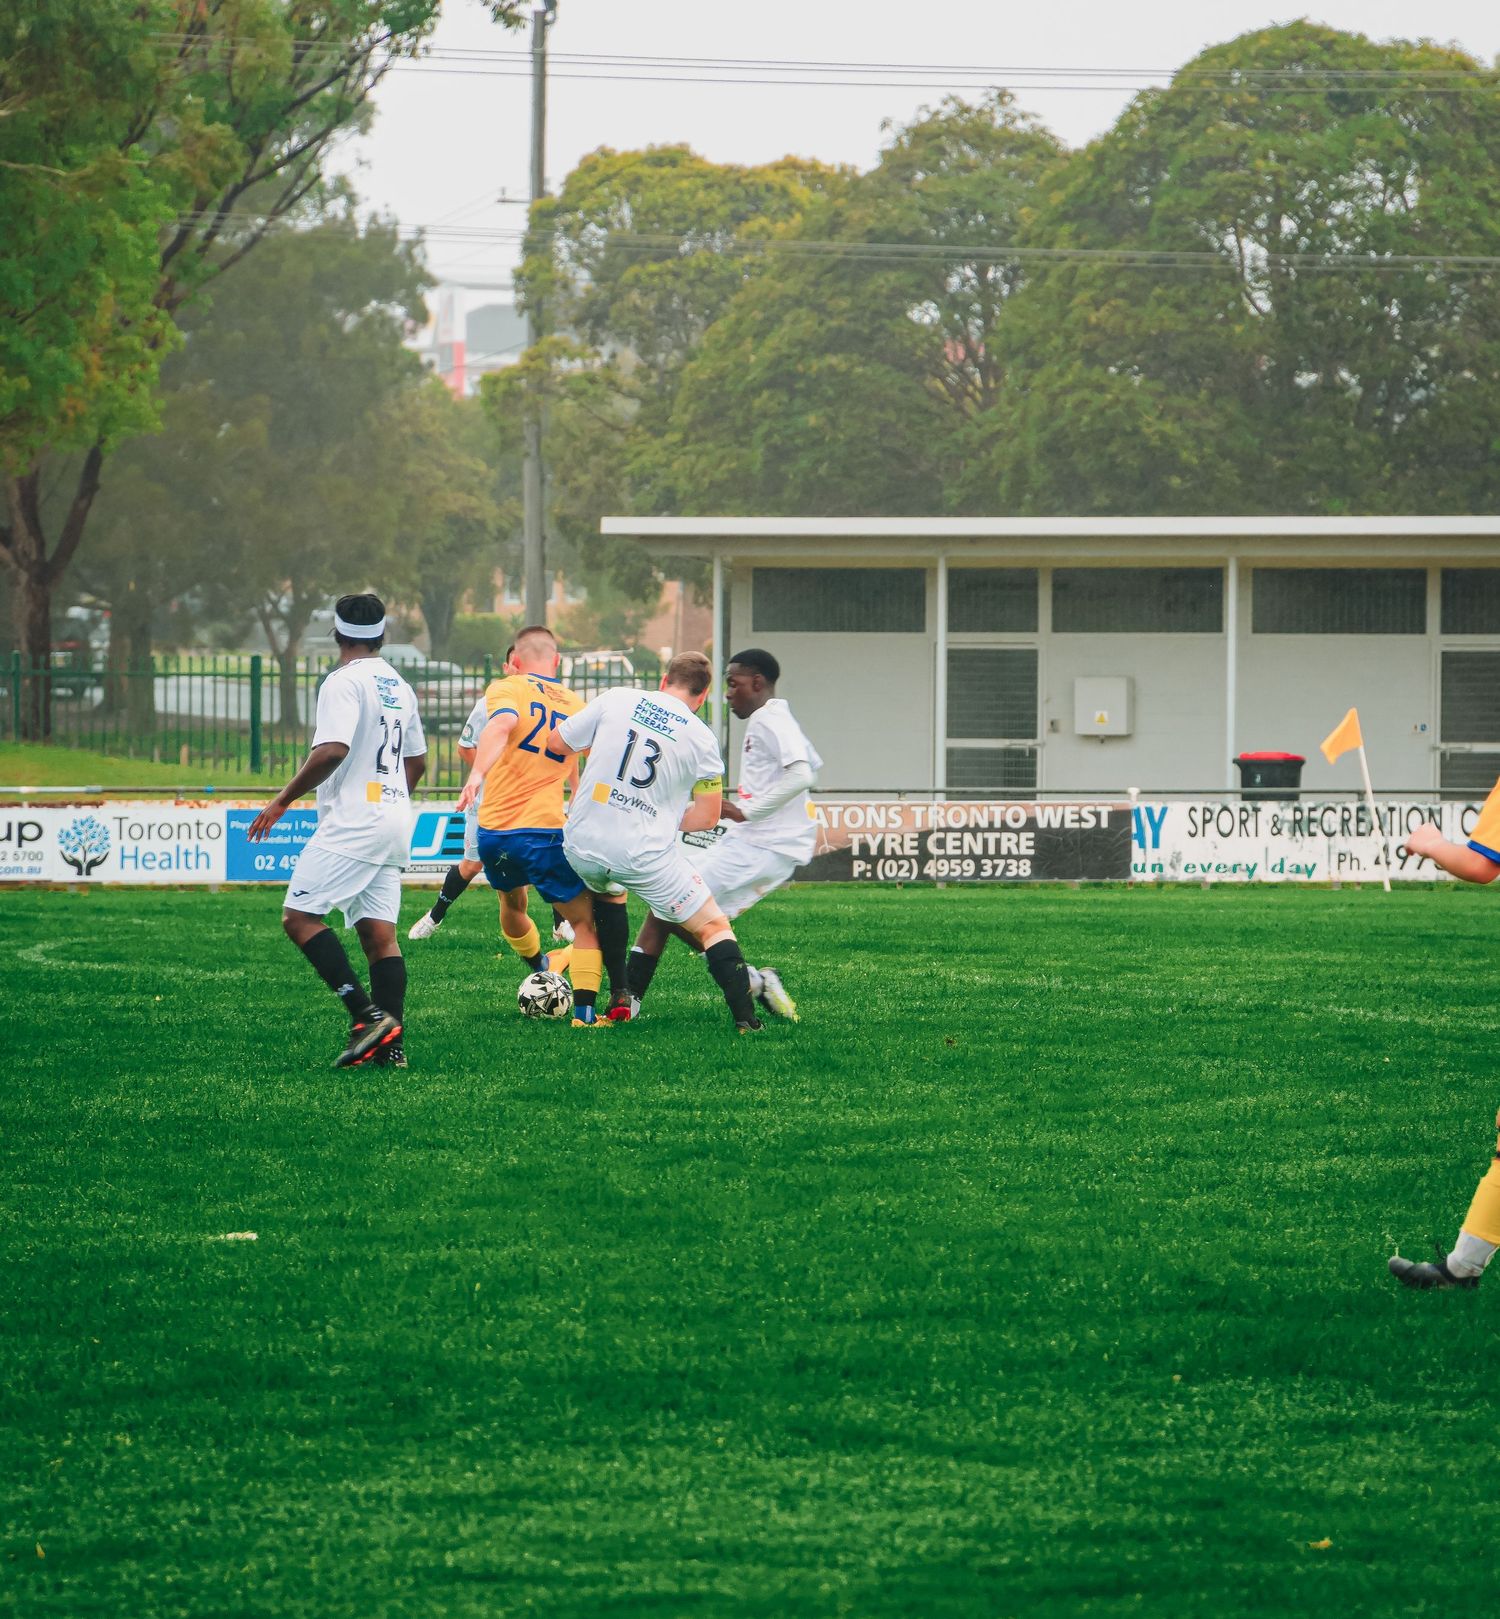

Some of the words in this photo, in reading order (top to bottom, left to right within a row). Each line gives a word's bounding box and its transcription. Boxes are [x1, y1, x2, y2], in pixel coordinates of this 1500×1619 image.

[633, 710, 675, 735] THERAPY
[635, 703, 669, 724] PHYSIO
[641, 697, 688, 725] THORNTON
[616, 728, 662, 788] 13
[112, 816, 222, 841] Toronto
[911, 805, 1028, 829] TRONTO
[1034, 805, 1113, 829] WEST
[1188, 805, 1262, 837] SPORT
[1270, 813, 1283, 836] &
[13, 850, 44, 861] 5700
[847, 832, 919, 856] TYRE
[927, 831, 1035, 856] CENTRE
[120, 844, 211, 871] Health
[254, 854, 276, 871] 02
[853, 859, 872, 877] P:
[876, 857, 919, 881] (02)
[923, 859, 976, 877] 4959
[980, 858, 1032, 877] 3738
[1184, 863, 1258, 879] every
[1271, 857, 1317, 879] day
[1337, 852, 1367, 871] Ph.
